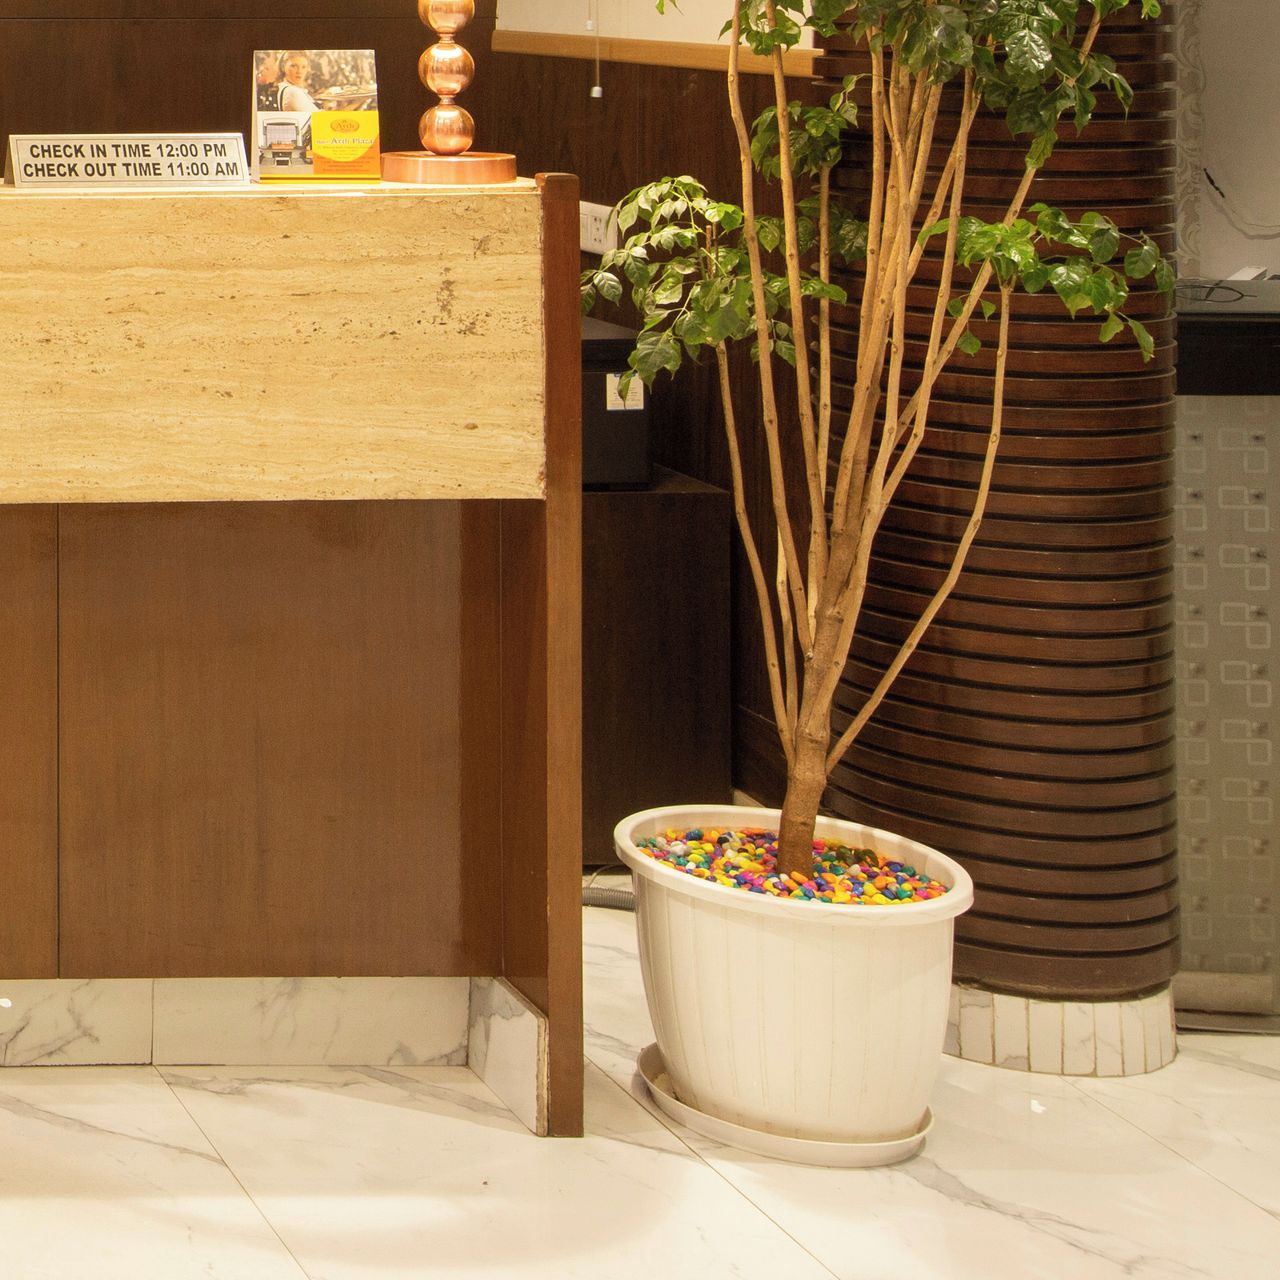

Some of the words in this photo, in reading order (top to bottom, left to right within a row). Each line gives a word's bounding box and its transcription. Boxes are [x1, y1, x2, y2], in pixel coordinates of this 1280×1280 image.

[30, 144, 85, 158] CHECK
[90, 144, 107, 158] IN
[112, 144, 151, 158] TIME
[156, 144, 198, 157] 12:00
[203, 144, 227, 157] PM
[23, 163, 79, 177] CHECK
[84, 163, 117, 177] OUT
[122, 163, 162, 176] TIME
[167, 162, 209, 176] 11:00
[215, 162, 239, 176] AM
